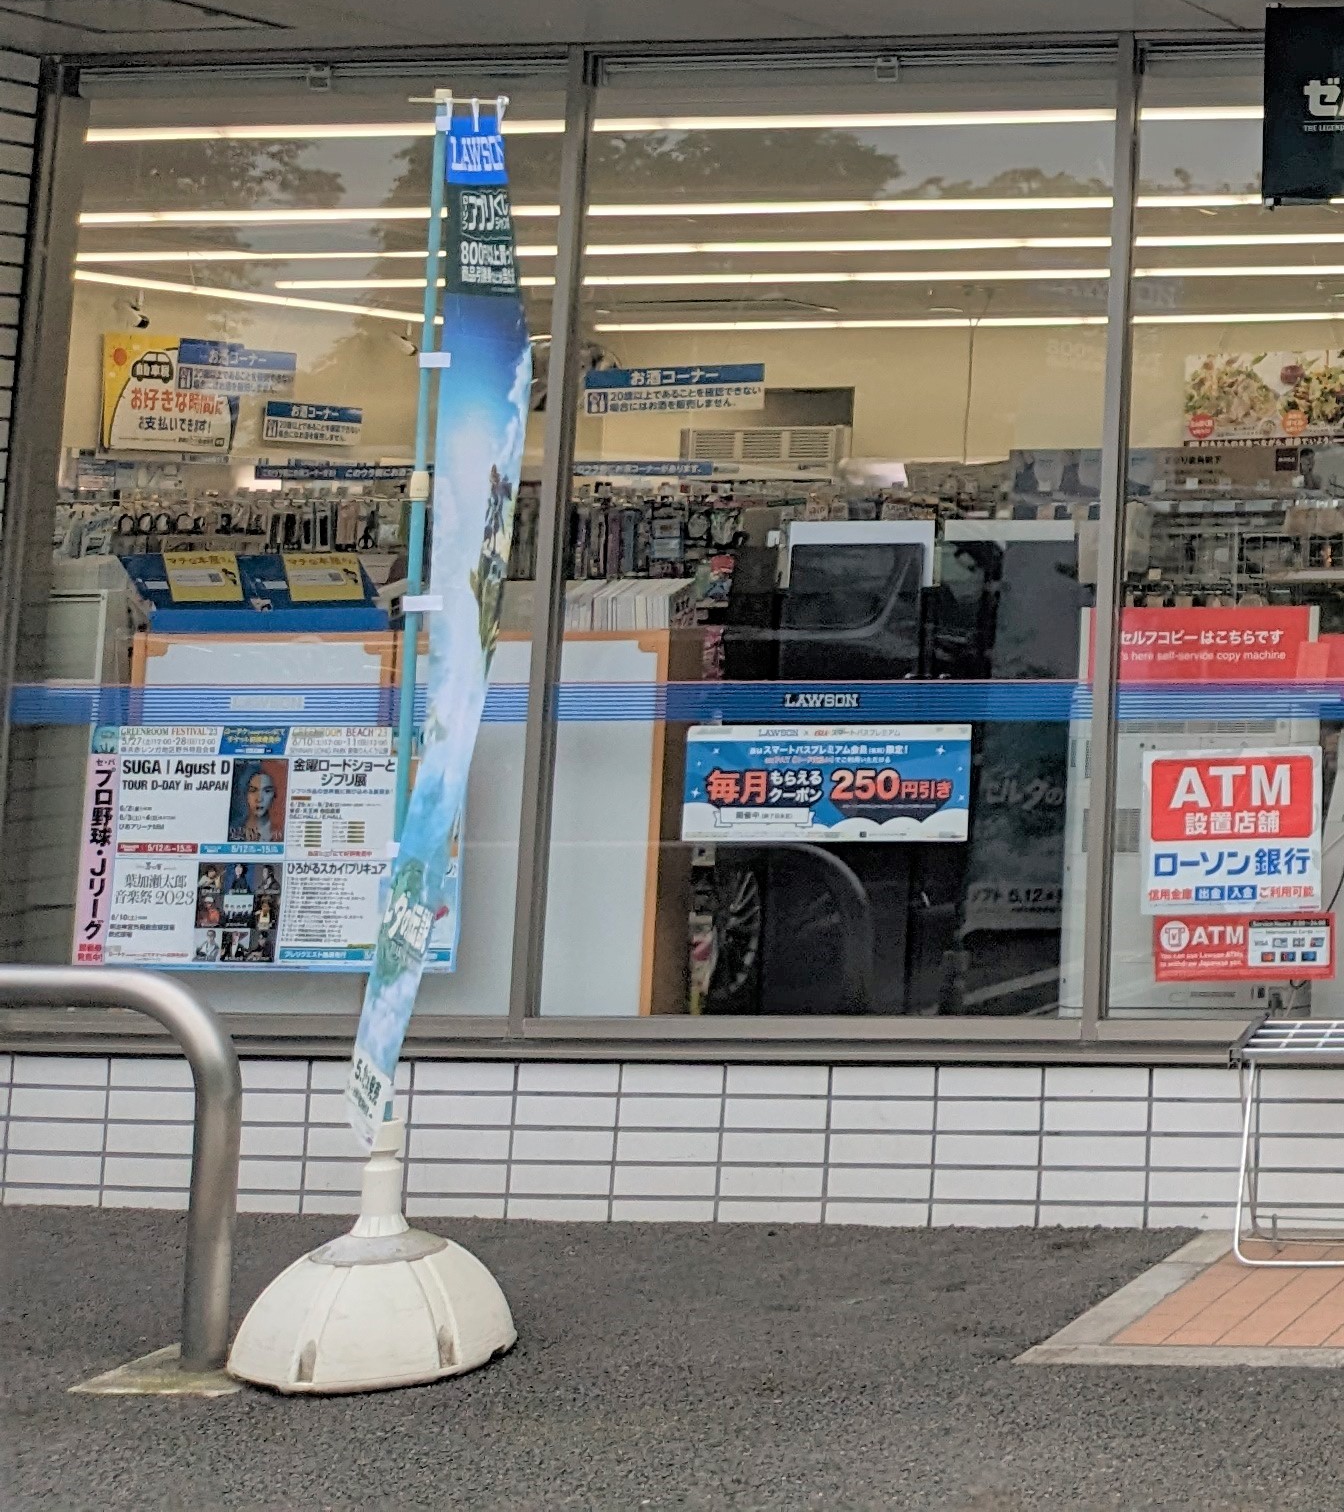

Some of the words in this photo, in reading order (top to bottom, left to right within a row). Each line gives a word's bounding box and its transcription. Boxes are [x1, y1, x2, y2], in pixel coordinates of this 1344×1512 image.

[1303, 124, 1318, 132] THE
[450, 135, 505, 172] LAWSO
[630, 368, 719, 386] お酒コーナー
[1121, 629, 1284, 646] セルフコピーはこちらです
[1131, 650, 1152, 661] here
[1157, 650, 1213, 661] self-service
[1216, 652, 1240, 662] copy
[1243, 650, 1286, 661] machine
[783, 693, 859, 708] LAWSON
[171, 727, 206, 736] FESTIVAL
[758, 728, 799, 737] LAWSON
[122, 759, 162, 775] SUGA
[174, 759, 217, 778] Agust
[220, 759, 231, 775] D
[292, 758, 396, 773] 金曜ロードショーと
[122, 779, 148, 791] TOUR
[151, 779, 182, 791] D-DAY
[183, 779, 193, 791] in
[195, 779, 230, 791] JAPAN
[320, 773, 368, 787] ジブリ展
[770, 770, 823, 786] もらえる
[829, 768, 953, 801] 250円引き
[707, 769, 769, 805] 毎月
[1168, 764, 1292, 810] ATM
[768, 788, 823, 803] クーポン
[1184, 810, 1280, 836] 設置店舗
[83, 768, 117, 941] プロ野球・Jリーグ
[1153, 846, 1314, 878] ローソン銀行
[286, 862, 388, 876] ひろがるスカイ!プリキュア
[155, 890, 195, 906] 2023
[1149, 888, 1193, 901] 信用金庫
[1198, 887, 1222, 900] 出金
[1229, 887, 1254, 900] 入金
[1259, 885, 1315, 899] ご利用可能
[1190, 925, 1244, 946] ATM
